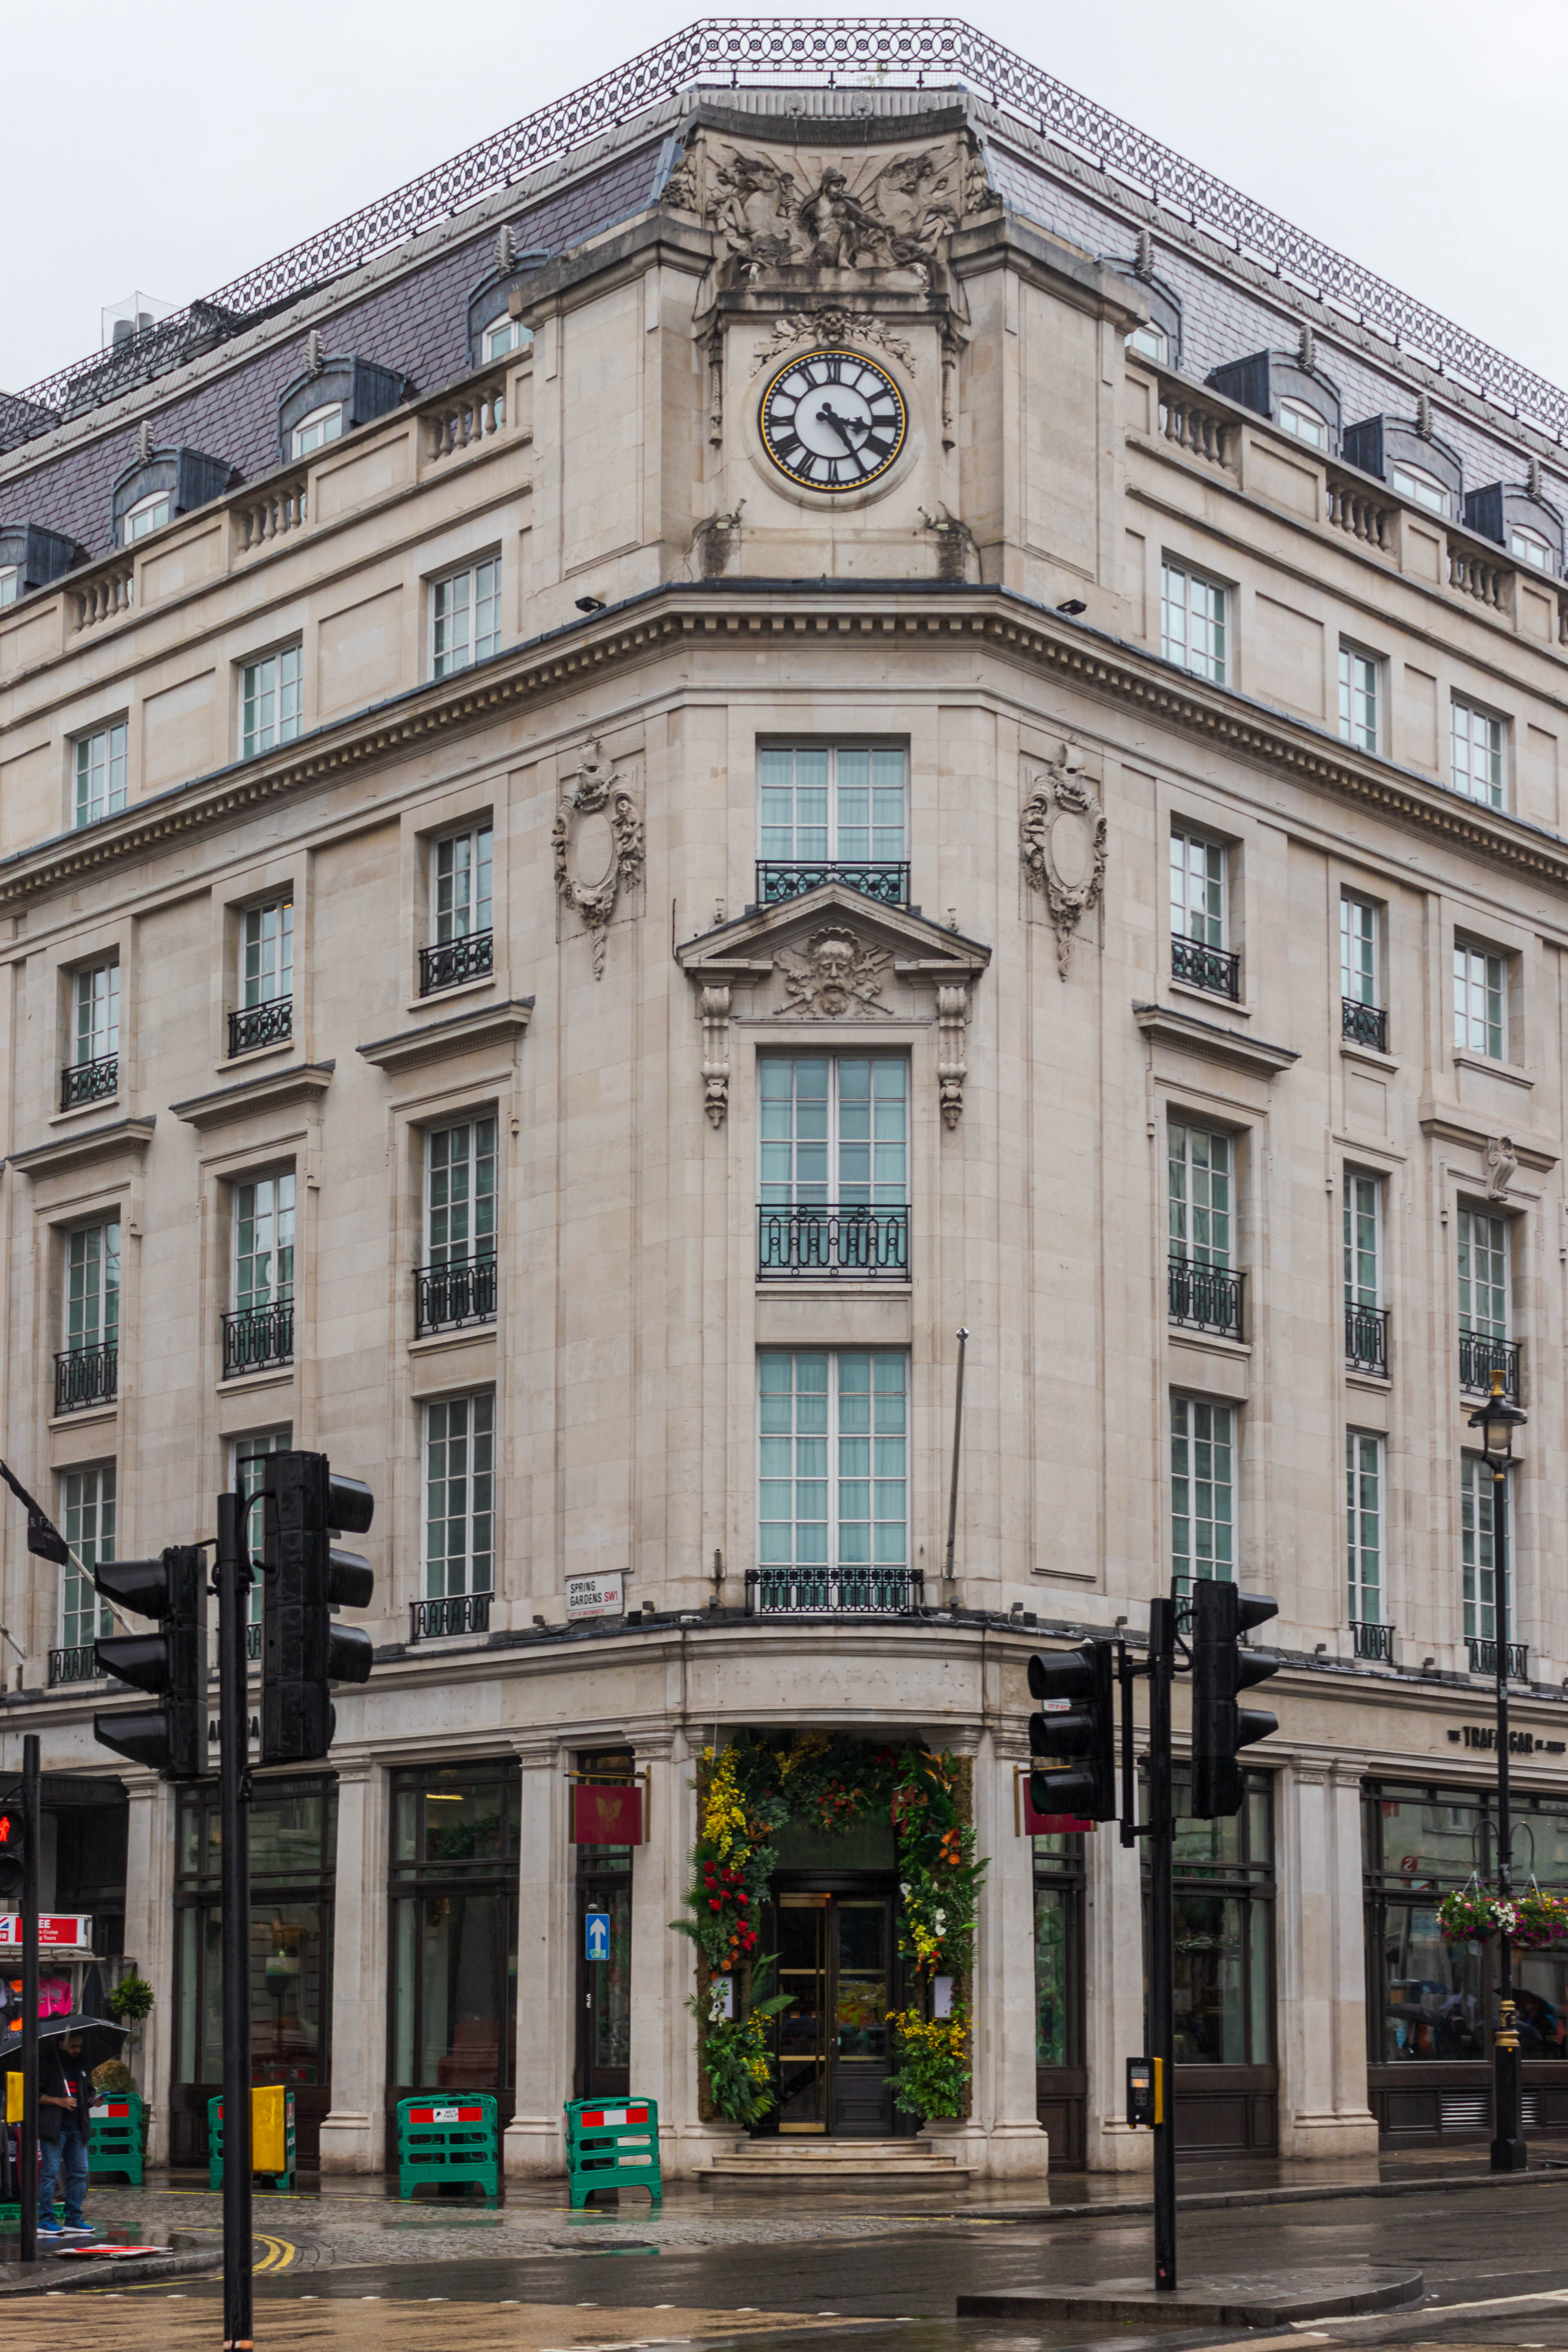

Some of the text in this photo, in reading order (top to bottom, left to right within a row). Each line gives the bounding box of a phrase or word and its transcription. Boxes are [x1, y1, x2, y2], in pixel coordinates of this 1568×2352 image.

[571, 1581, 595, 1594] SPRING
[571, 1591, 618, 1606] GARDENS SW1
[1463, 1726, 1533, 1753] TRAFGAR
